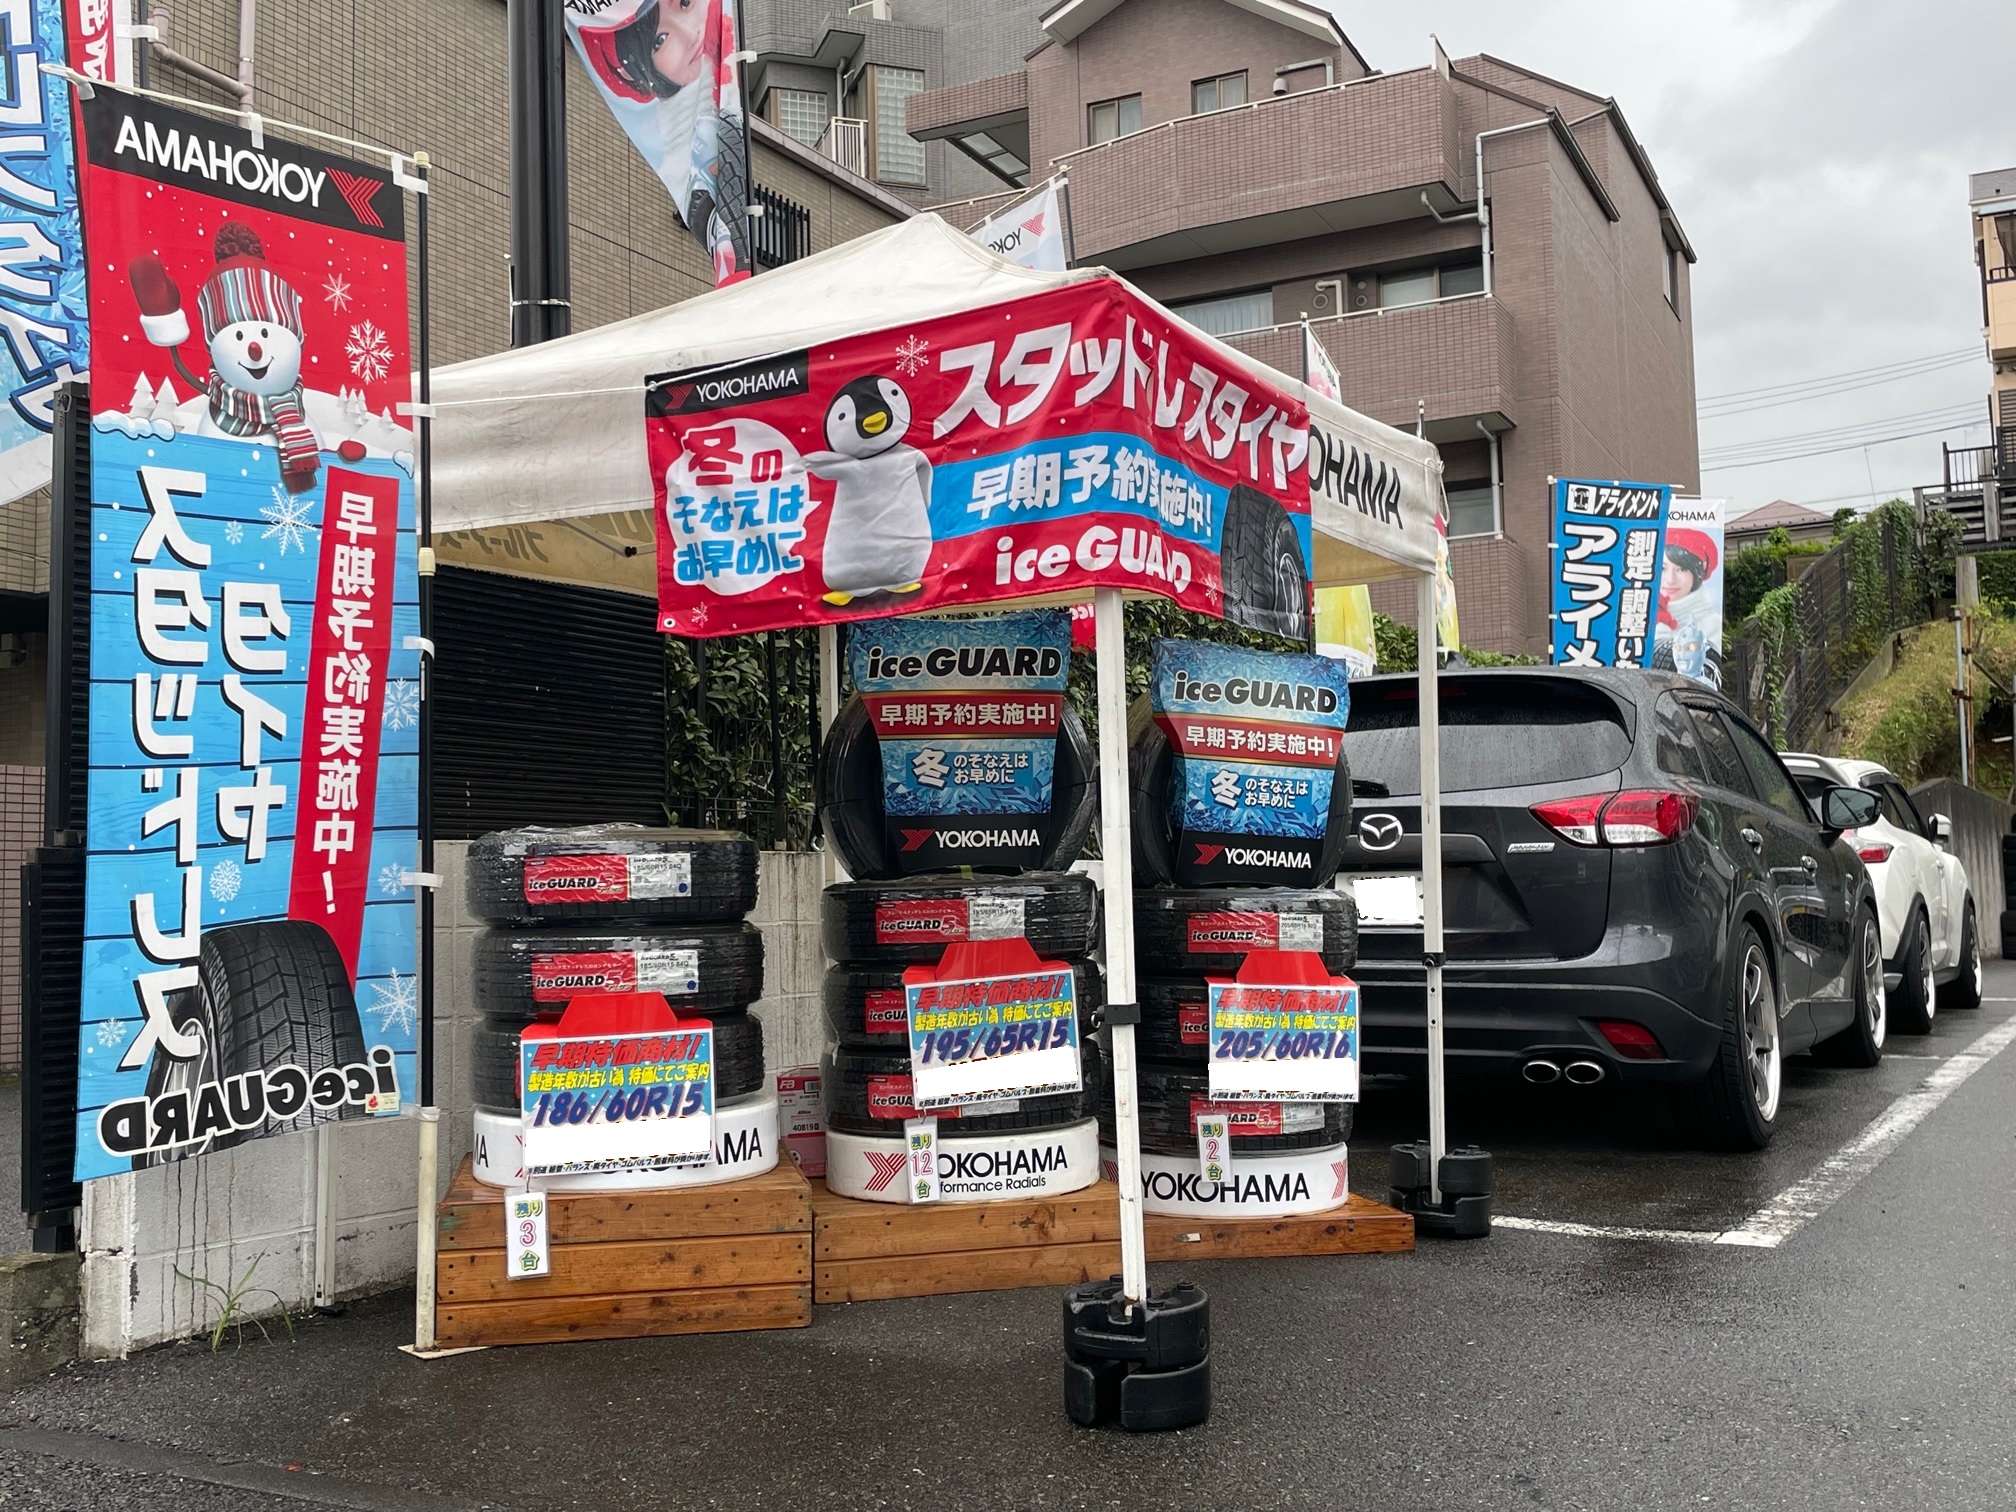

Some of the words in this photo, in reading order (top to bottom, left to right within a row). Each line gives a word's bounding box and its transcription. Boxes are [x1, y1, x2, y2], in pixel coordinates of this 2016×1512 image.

[696, 367, 799, 403] YOKOHAMA
[933, 313, 1308, 491] スタッドレスタイヤ
[688, 425, 784, 487] 冬の
[1310, 423, 1403, 530] OHAMA
[673, 484, 804, 535] そなえは
[1594, 488, 1660, 518] アライメント
[1667, 511, 1715, 521] KOHAMA
[677, 531, 803, 582] お早めに
[1559, 523, 1618, 667] アライメ
[1615, 530, 1658, 668] 測定・調整い
[880, 703, 1055, 727] 早期予約実施中!
[1186, 726, 1333, 758] 早期予約実施中!
[912, 748, 951, 789] 冬
[953, 753, 1028, 769] のそなえは
[953, 768, 1015, 784] お早めに
[1211, 769, 1243, 809] 冬
[1246, 778, 1308, 795] のそなえは
[1245, 794, 1295, 808] お早めに
[935, 829, 1040, 848] YOKOHAMA
[1225, 847, 1312, 869] YOKOHAMA
[916, 975, 1065, 1012] 早期特価商材!
[1217, 988, 1350, 1013] 早期特価商材!
[870, 1010, 907, 1021] iceGUA
[1002, 1000, 1073, 1022] 特価にてご案内
[1294, 1014, 1355, 1030] 特価にてご案内
[530, 1035, 703, 1071] 早期特価商材!
[922, 1018, 1070, 1063] 195/65R15
[1215, 1030, 1351, 1059] 205/60R16
[629, 1062, 710, 1085] 特価にてご案内
[780, 1080, 795, 1089] FB
[533, 1082, 705, 1127] 186/60R15
[872, 1095, 914, 1106] iceGUA
[909, 1133, 932, 1150] 残り
[1200, 1123, 1224, 1138] 残り
[938, 1145, 1068, 1179] OKOHAMA
[1206, 1139, 1220, 1162] 2
[910, 1151, 934, 1177] 12
[1206, 1163, 1222, 1180] 台
[914, 1179, 931, 1198] 台
[940, 1178, 1003, 1194] formance
[1006, 1174, 1046, 1190] Radials
[1141, 1171, 1311, 1203] YOKOHAMA
[515, 1200, 543, 1217] 残り
[519, 1219, 537, 1246] 3
[520, 1250, 539, 1271] 台
